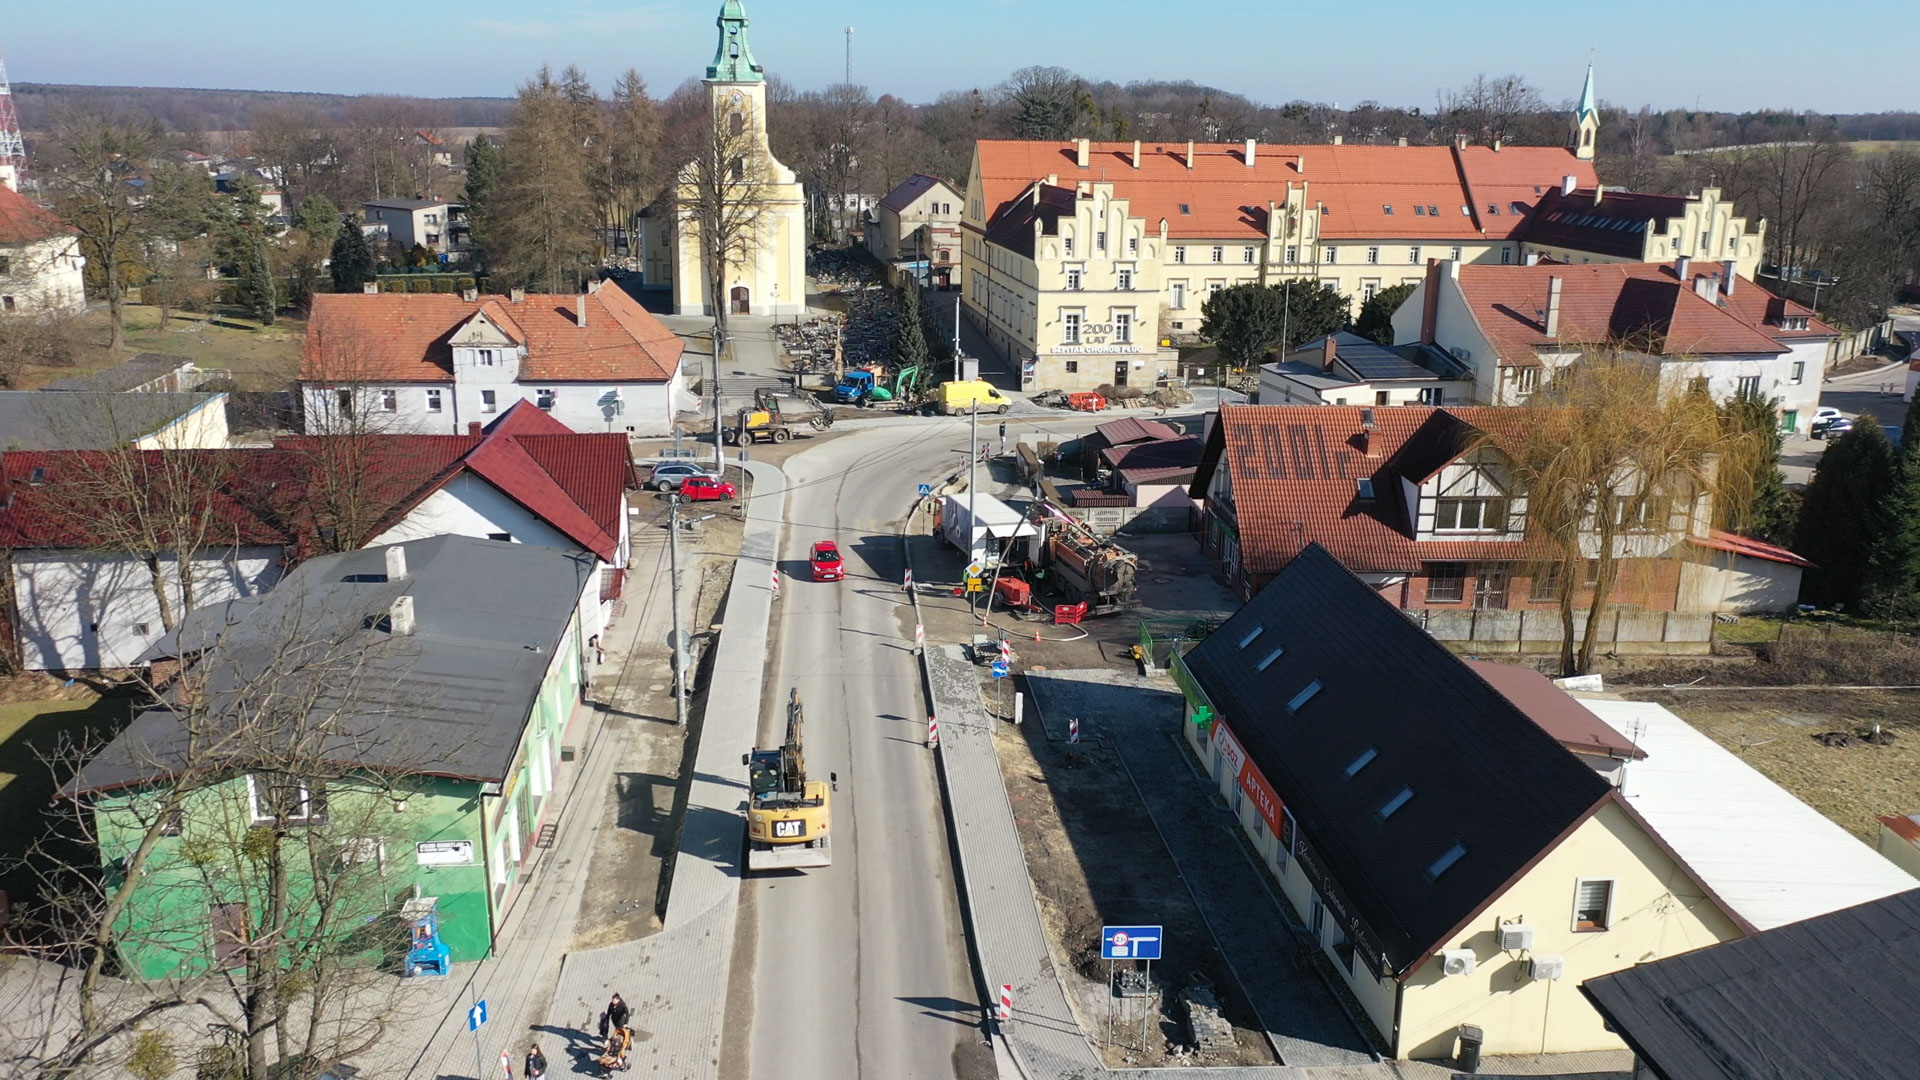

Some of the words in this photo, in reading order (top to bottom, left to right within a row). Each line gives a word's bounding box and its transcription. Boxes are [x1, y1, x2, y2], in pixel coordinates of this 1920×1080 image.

[1082, 324, 1113, 334] 200
[1086, 336, 1107, 344] LAT
[1246, 771, 1275, 823] APTEKA
[776, 821, 800, 837] CAT
